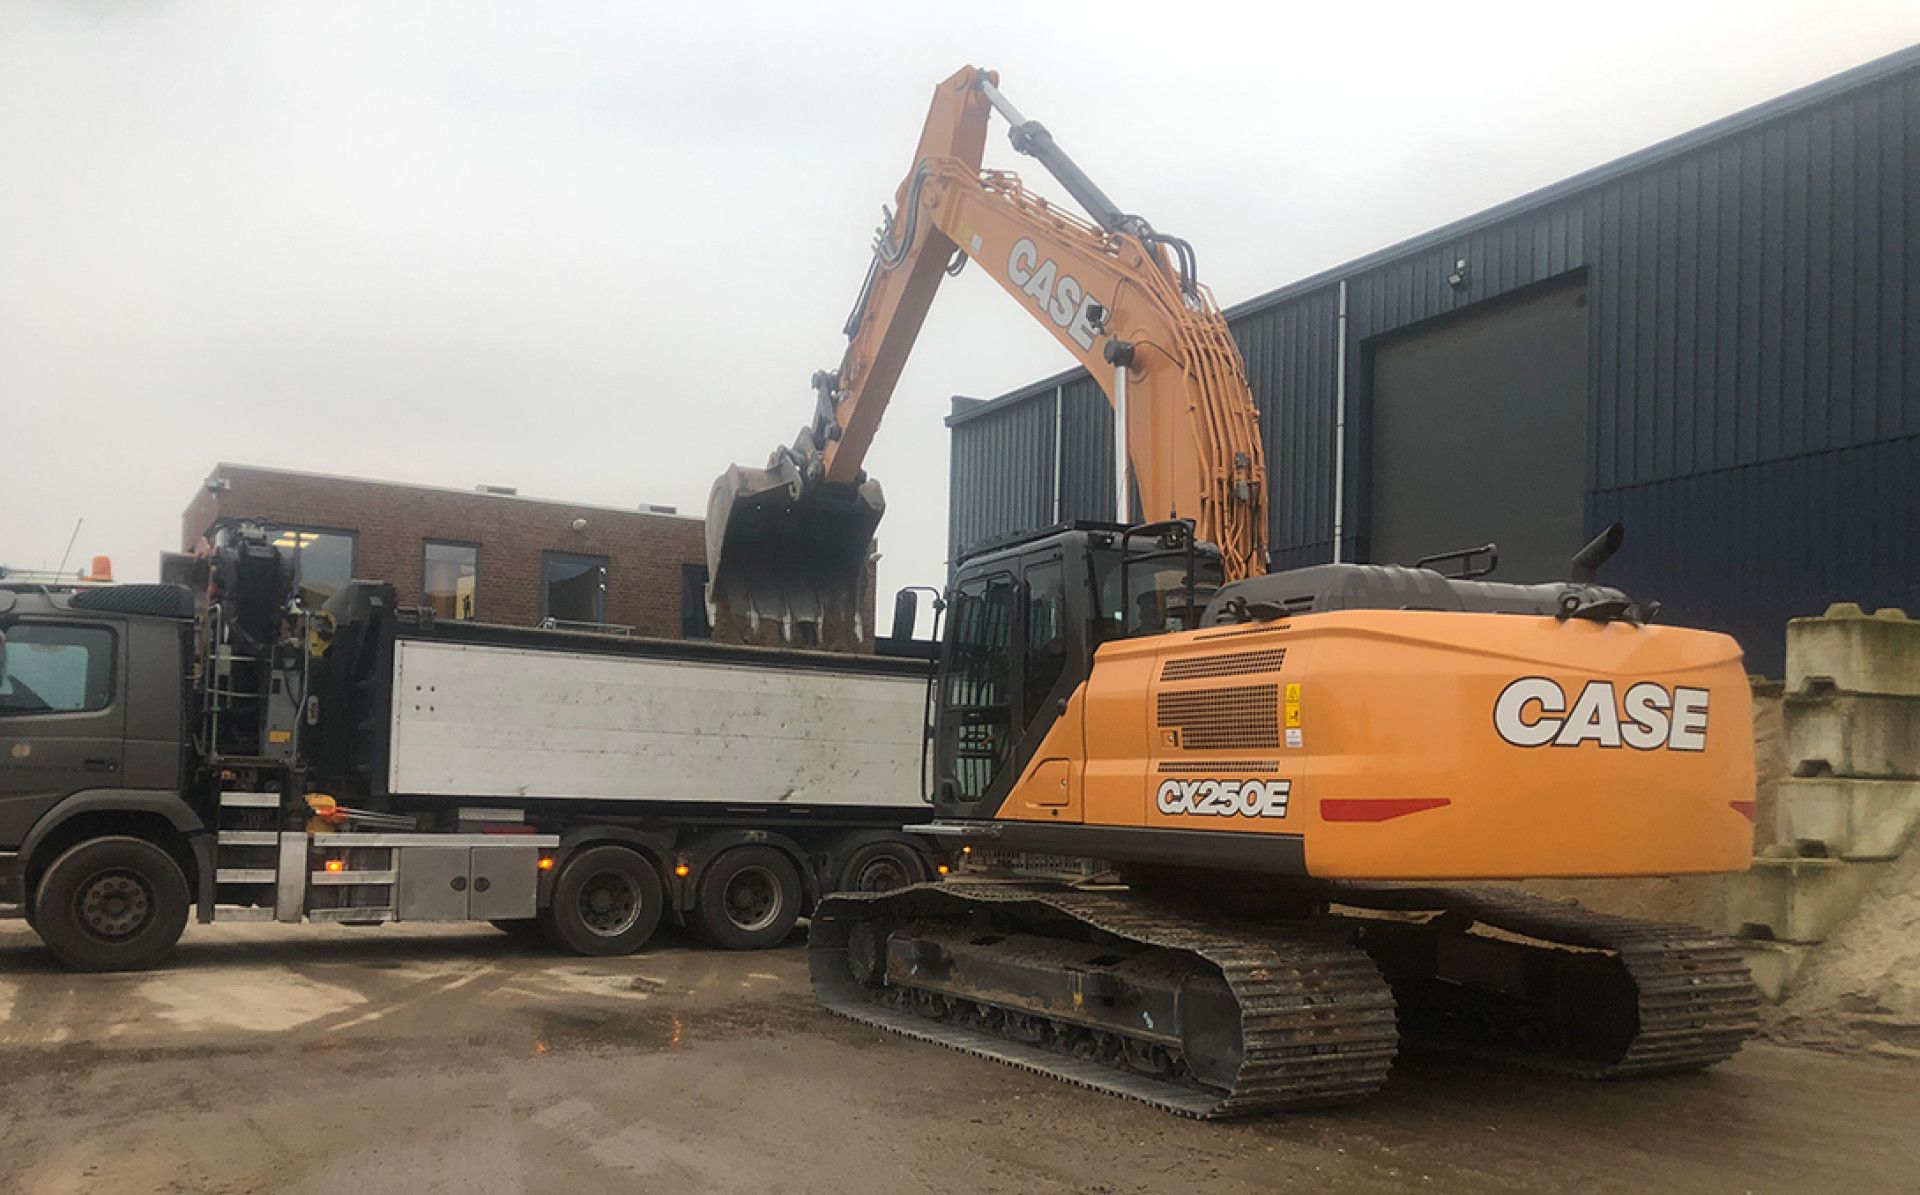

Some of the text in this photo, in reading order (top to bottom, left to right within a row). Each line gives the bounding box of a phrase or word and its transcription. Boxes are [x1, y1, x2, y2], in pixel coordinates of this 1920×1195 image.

[1008, 237, 1109, 352] CASE
[1493, 676, 1710, 752] CASE
[1157, 779, 1291, 818] CX250E
